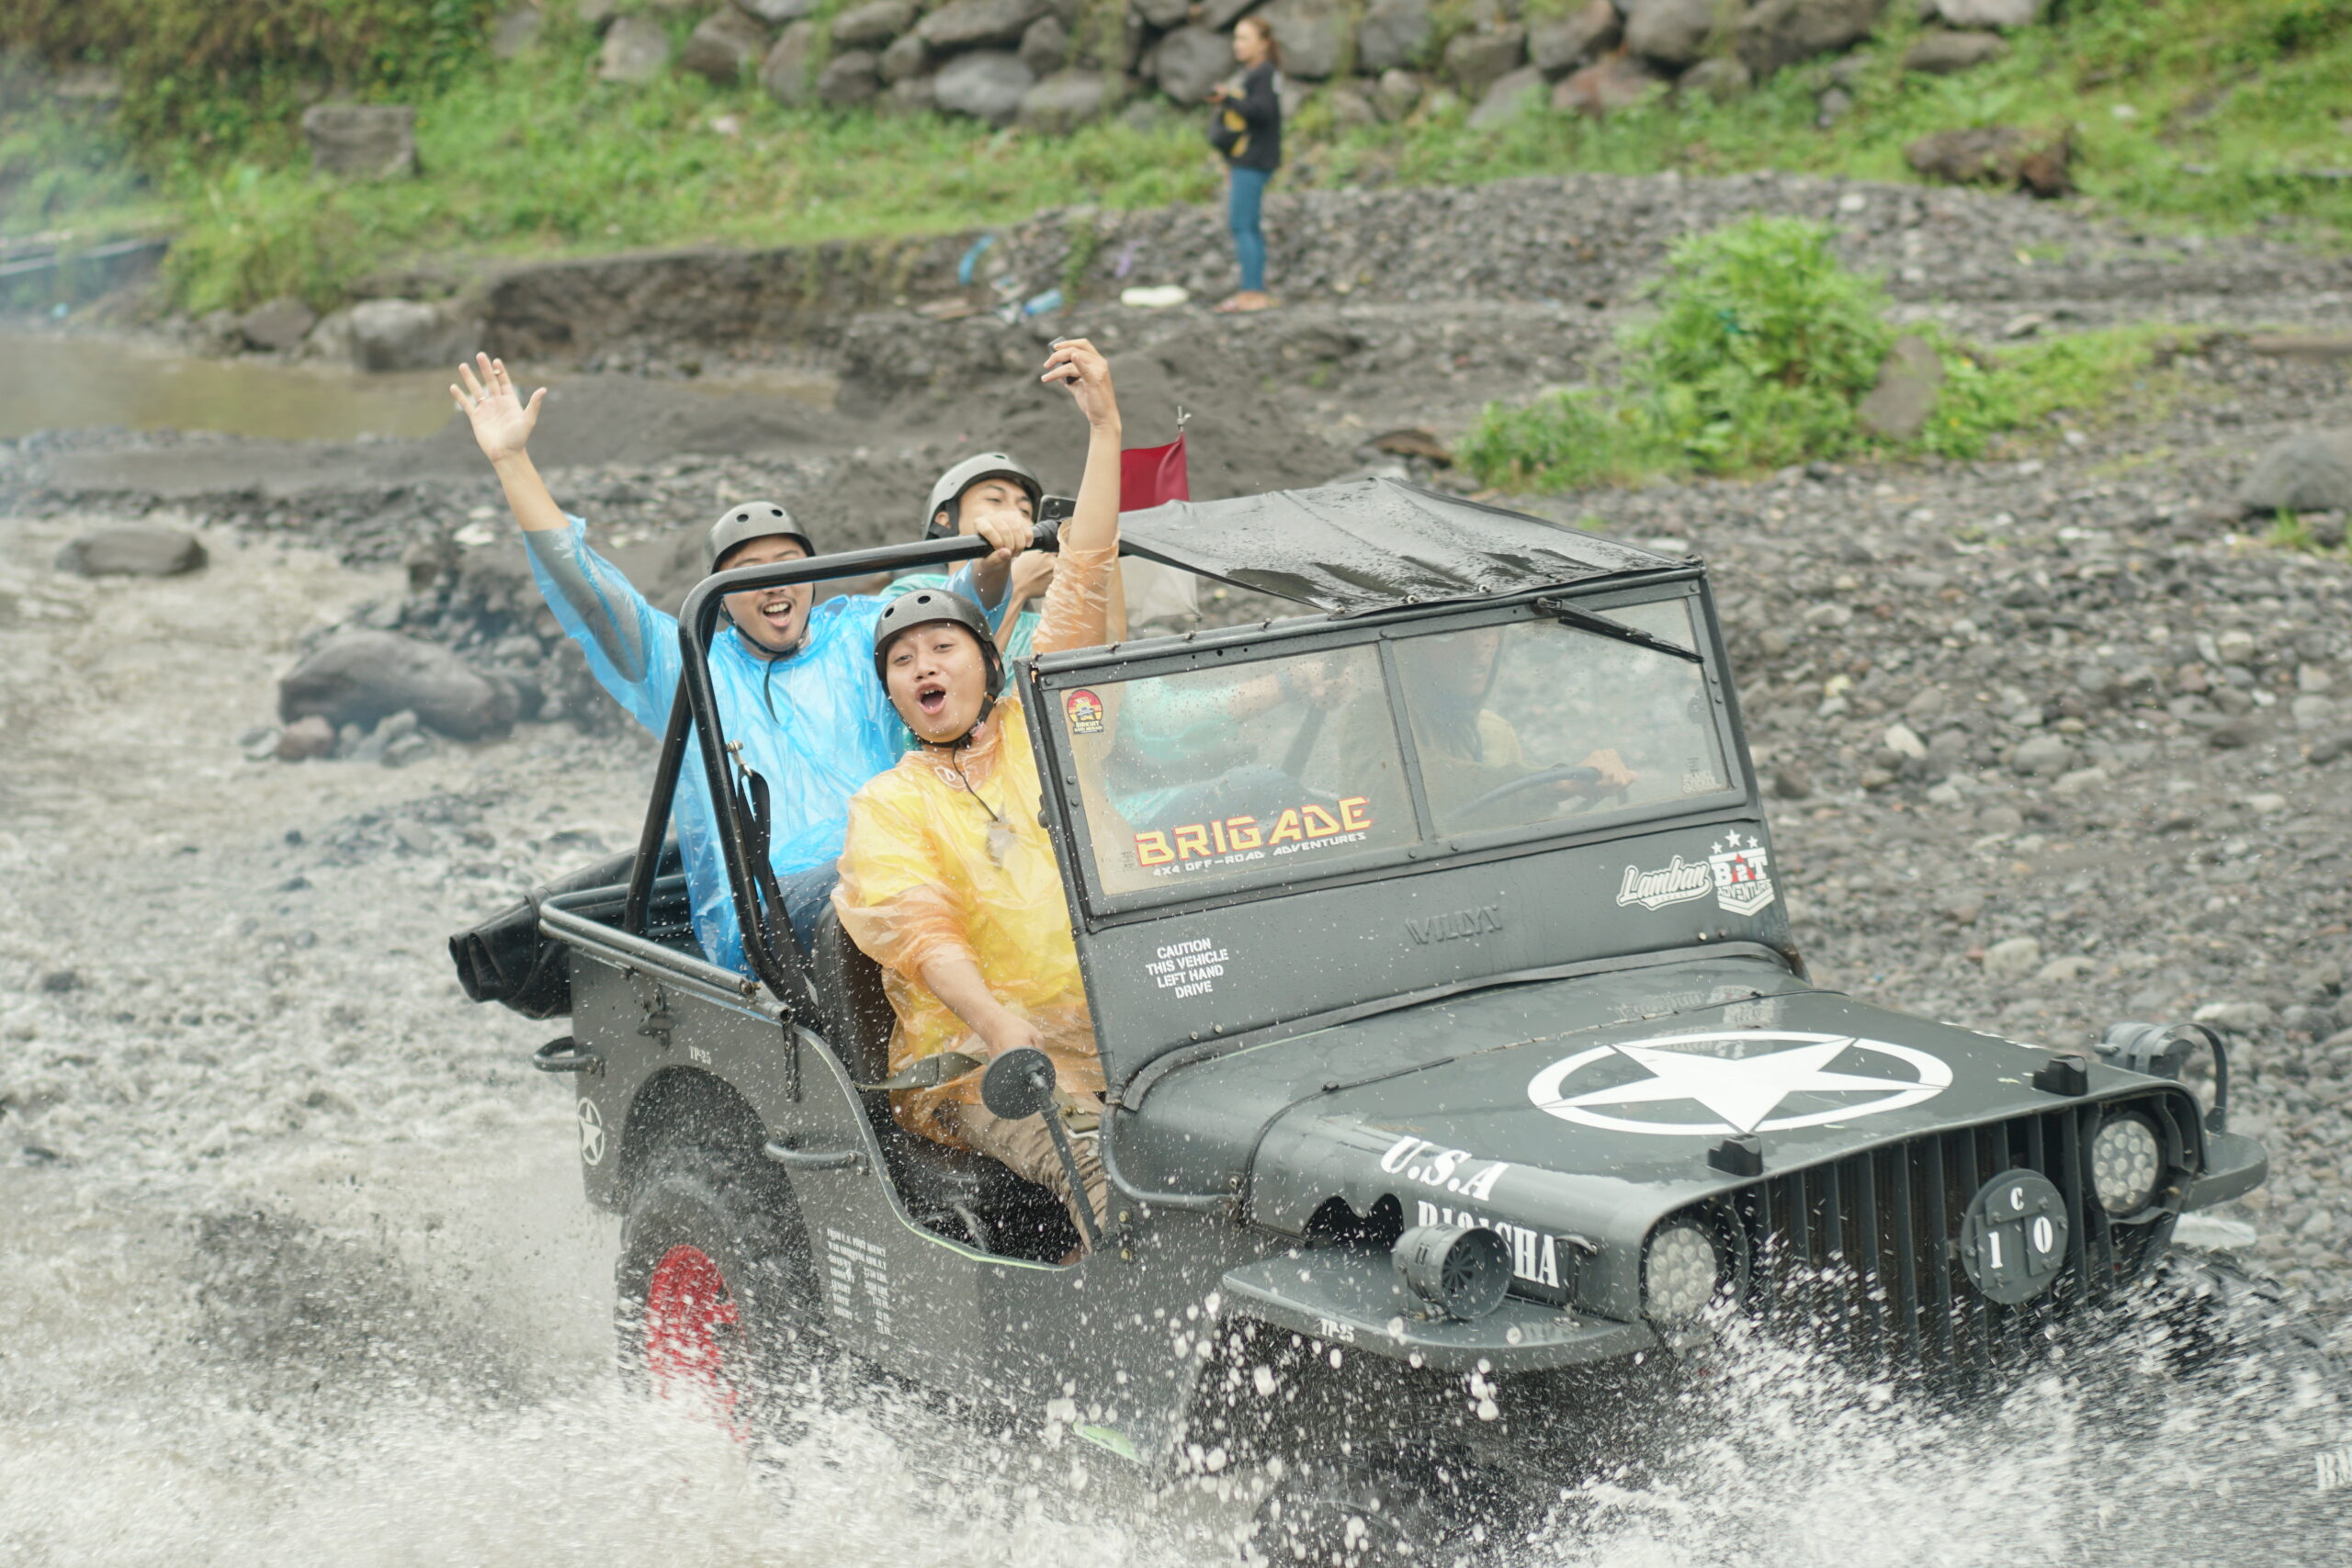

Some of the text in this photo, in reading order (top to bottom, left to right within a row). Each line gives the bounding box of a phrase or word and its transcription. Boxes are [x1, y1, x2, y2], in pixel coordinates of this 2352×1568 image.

[1136, 796, 1373, 866] BRIGADE
[1184, 851, 1266, 872] OFF-ROAD
[1272, 831, 1367, 856] ADVENTURES
[1157, 937, 1212, 960] CAUTION
[1145, 948, 1229, 976] THIS VEHICLE
[1157, 964, 1224, 989] LEFT HAND
[1175, 980, 1214, 999] DRIVE
[1380, 1135, 1510, 1201] U.S.A
[2010, 1187, 2025, 1211] C
